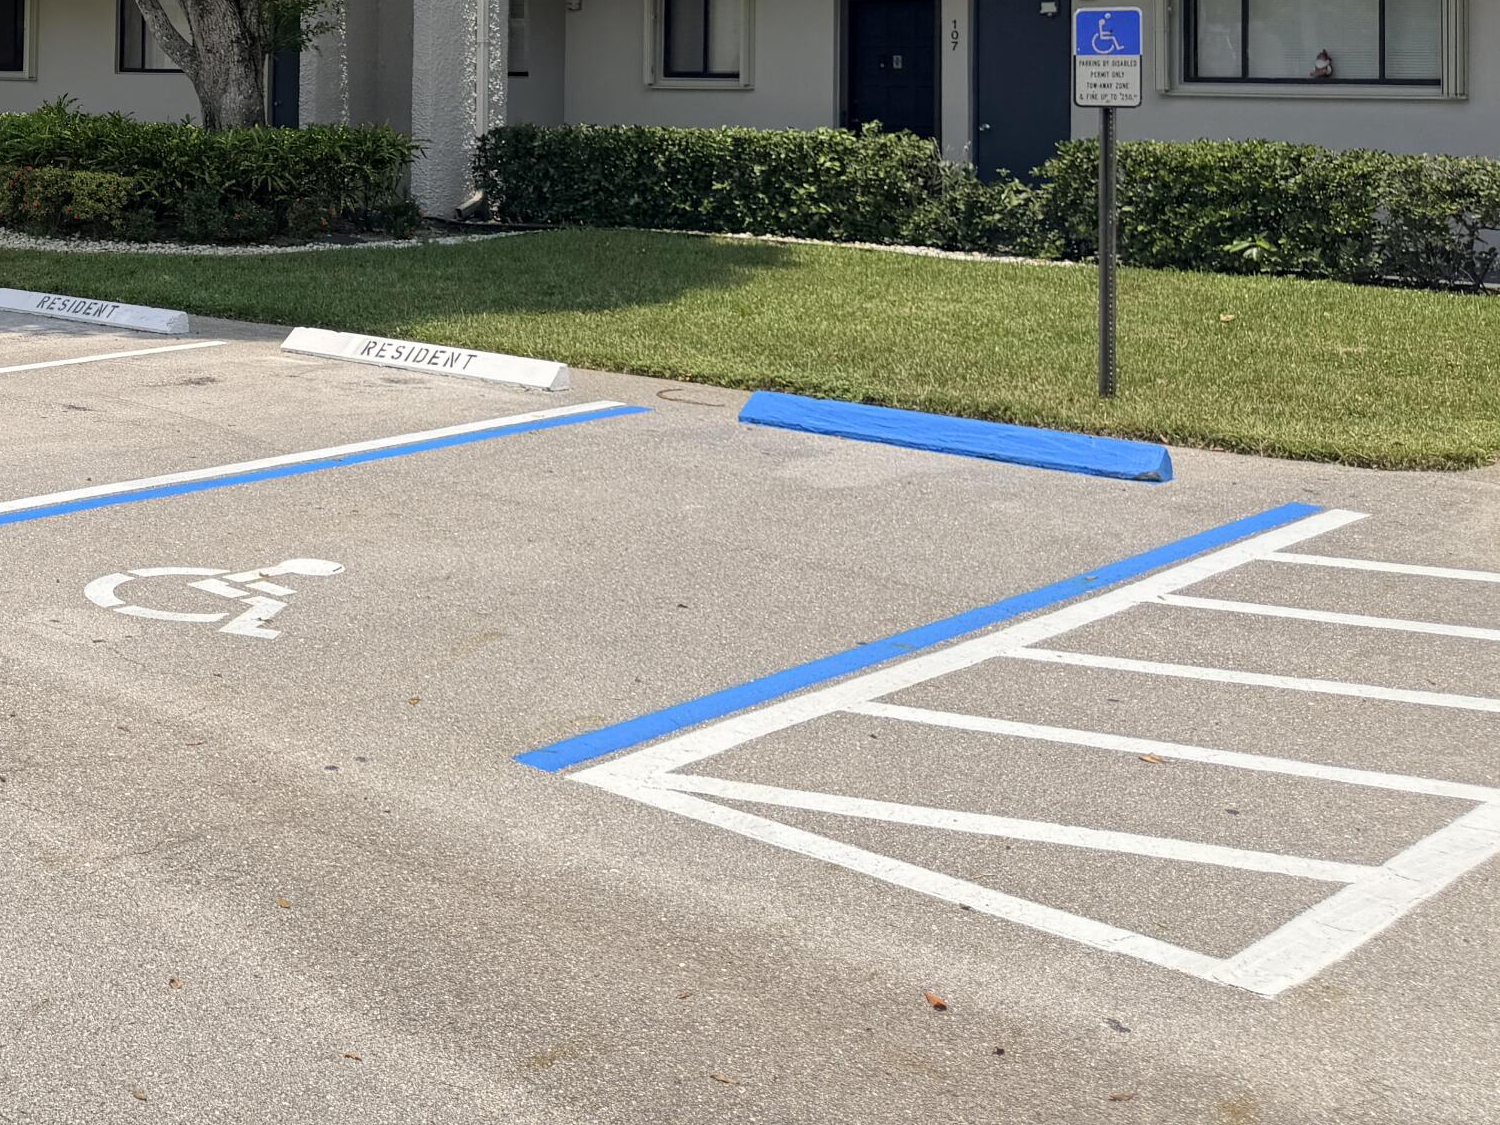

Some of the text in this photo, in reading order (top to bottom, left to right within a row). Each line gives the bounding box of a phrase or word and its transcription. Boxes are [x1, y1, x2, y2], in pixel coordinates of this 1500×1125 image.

[951, 19, 959, 51] 107
[1079, 59, 1137, 67] PARKING BY DISABLED
[36, 295, 120, 318] RESIDENT
[360, 340, 478, 370] RESIDENT
